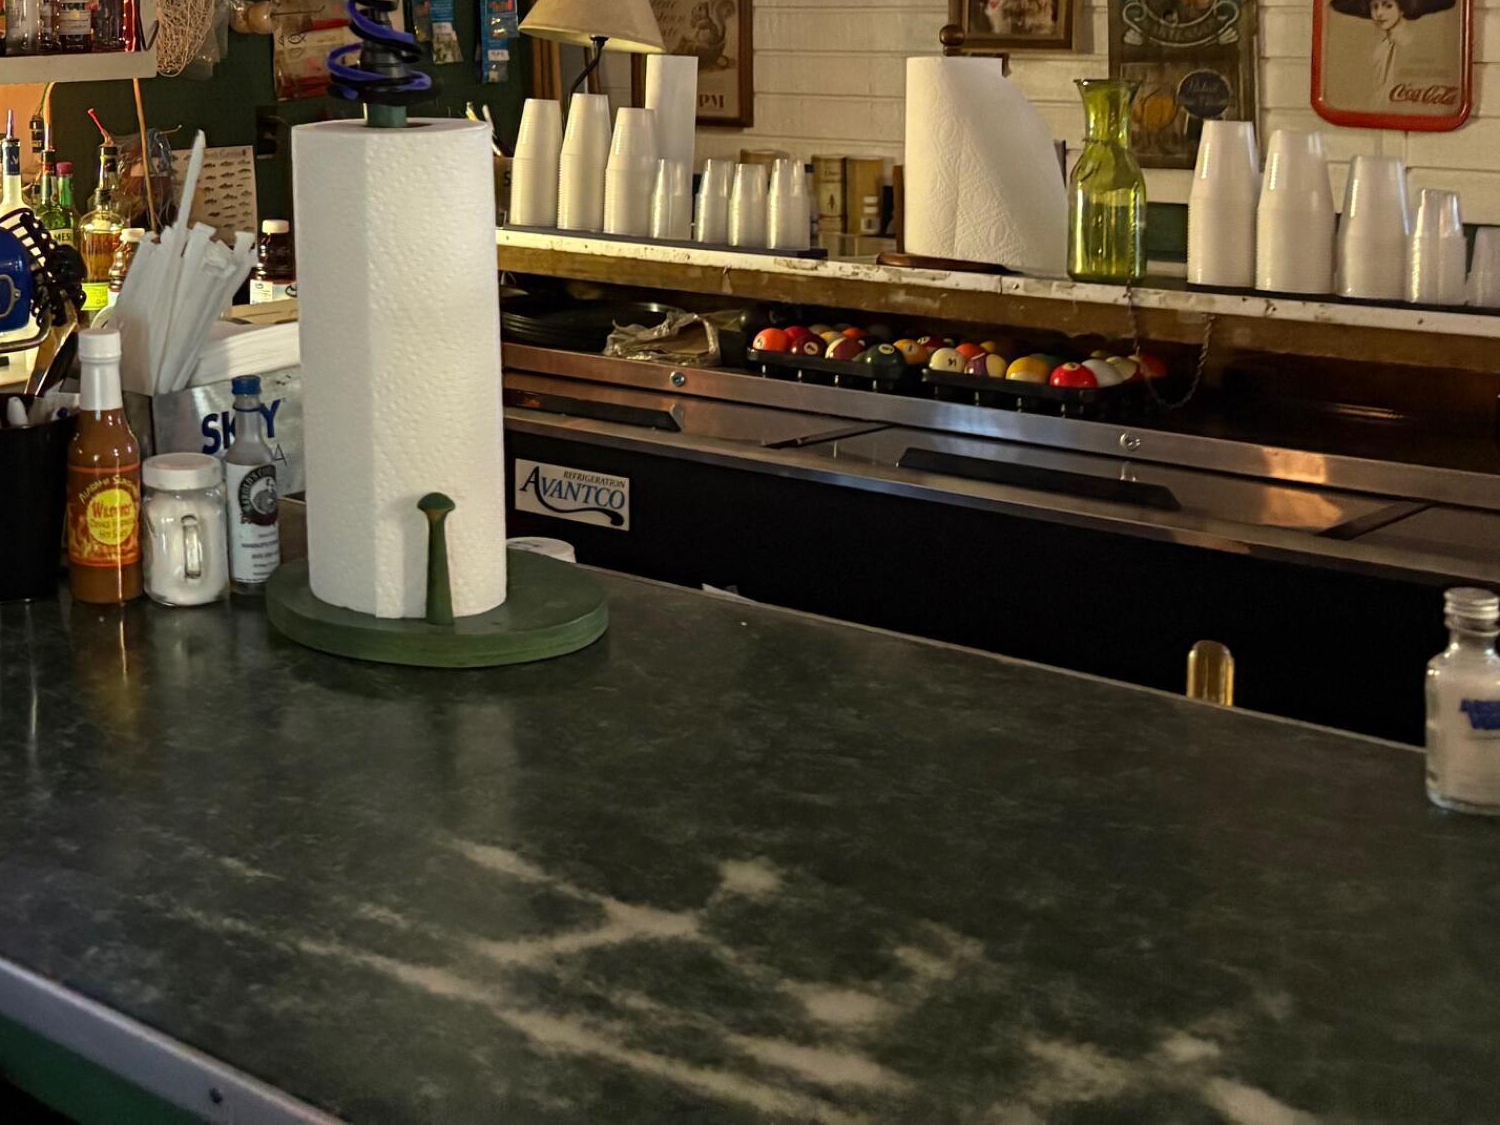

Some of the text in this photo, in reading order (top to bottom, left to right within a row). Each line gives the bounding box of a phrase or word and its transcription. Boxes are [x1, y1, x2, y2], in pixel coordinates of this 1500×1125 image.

[201, 399, 281, 455] SKY
[519, 466, 626, 513] AVANTCO
[563, 470, 626, 488] REFRIGERATION
